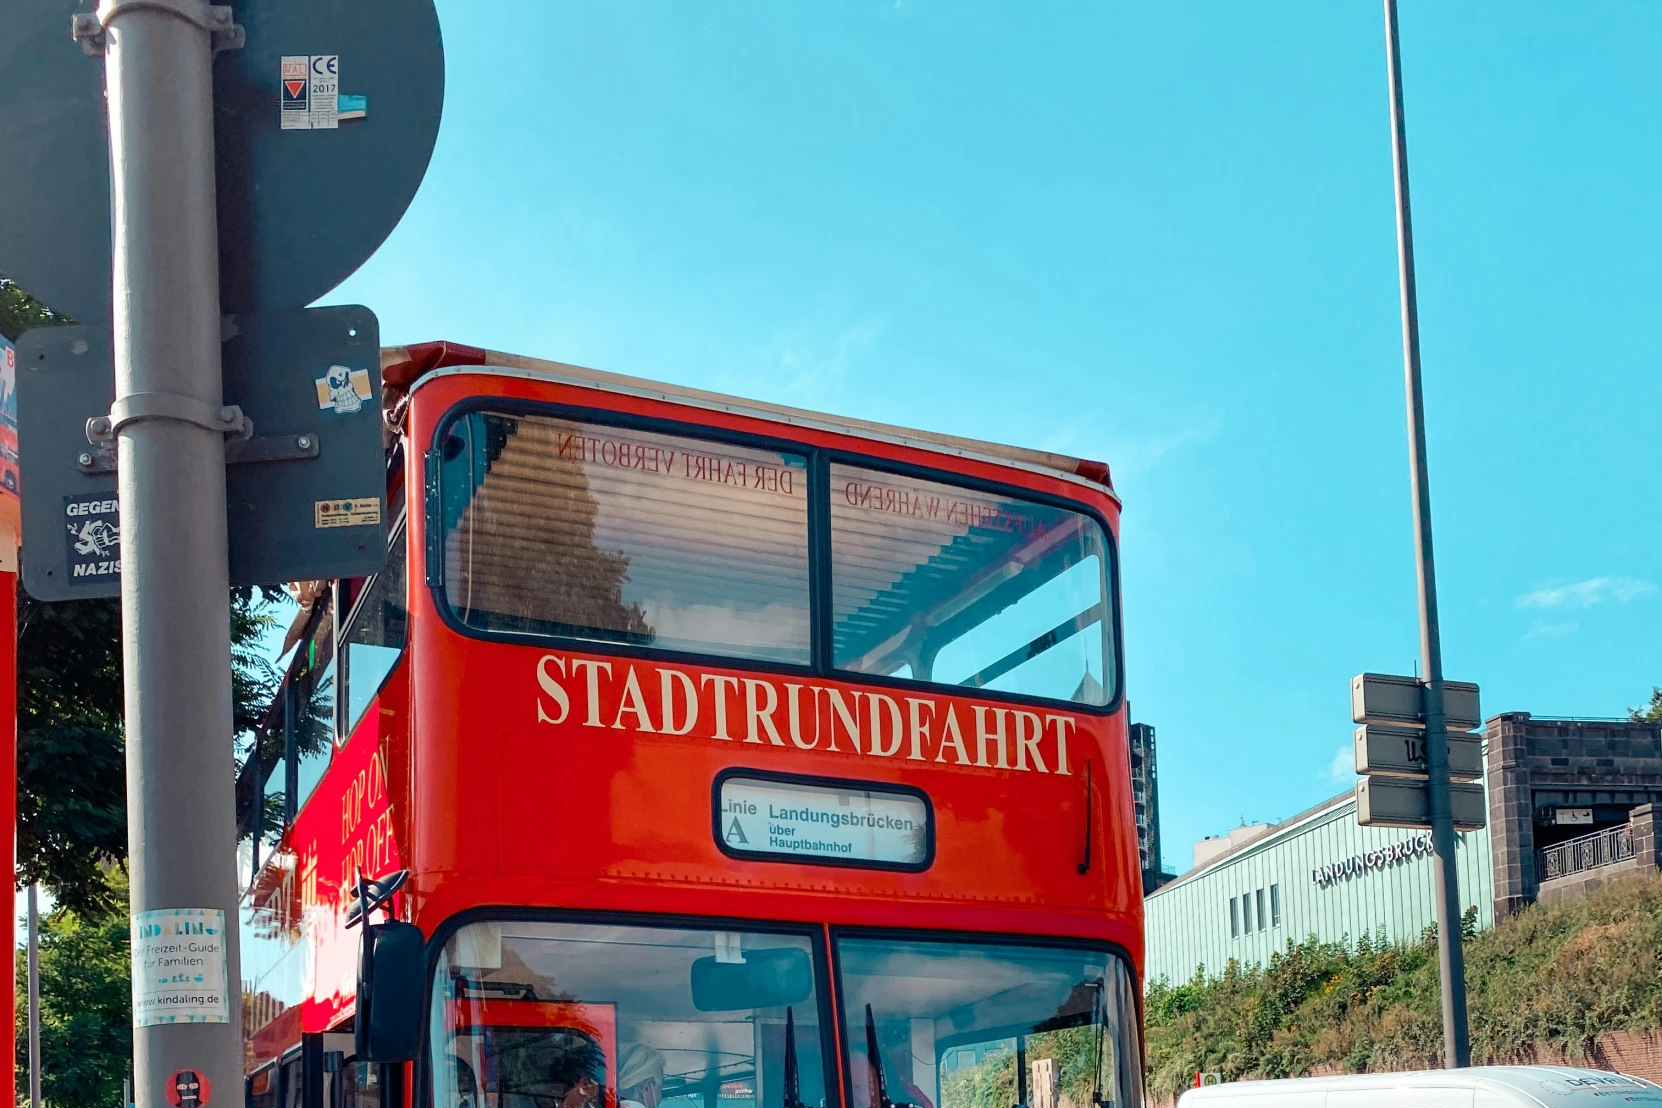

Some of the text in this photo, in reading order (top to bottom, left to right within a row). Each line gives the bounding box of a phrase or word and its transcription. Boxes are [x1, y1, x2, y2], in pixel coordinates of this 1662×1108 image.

[312, 56, 337, 75] CE
[313, 84, 336, 93] 2017
[536, 654, 1076, 777] STADTRUNDFAHRT
[341, 769, 366, 846] HOP
[769, 804, 914, 831] Landungsbrücken
[725, 815, 749, 844] A
[769, 836, 853, 853] Hauptbahnhof
[158, 956, 204, 967] Familien
